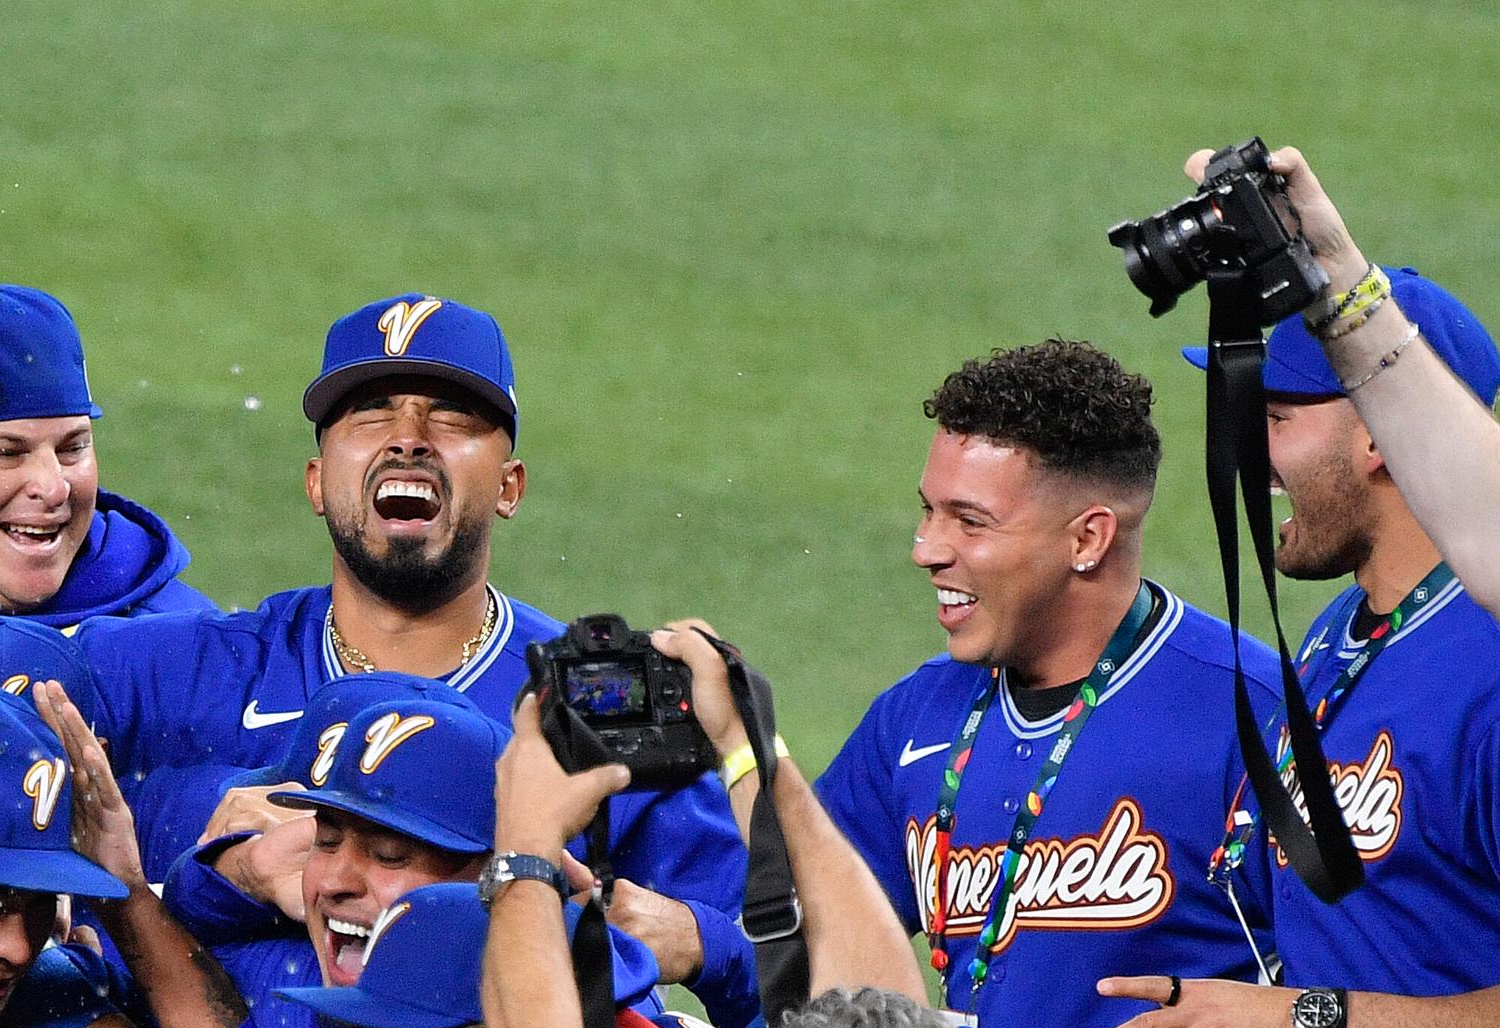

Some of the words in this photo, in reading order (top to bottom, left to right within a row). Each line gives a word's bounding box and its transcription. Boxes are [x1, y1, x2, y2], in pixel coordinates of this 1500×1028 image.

[377, 300, 443, 357] V
[359, 711, 436, 775] V
[23, 758, 67, 831] V
